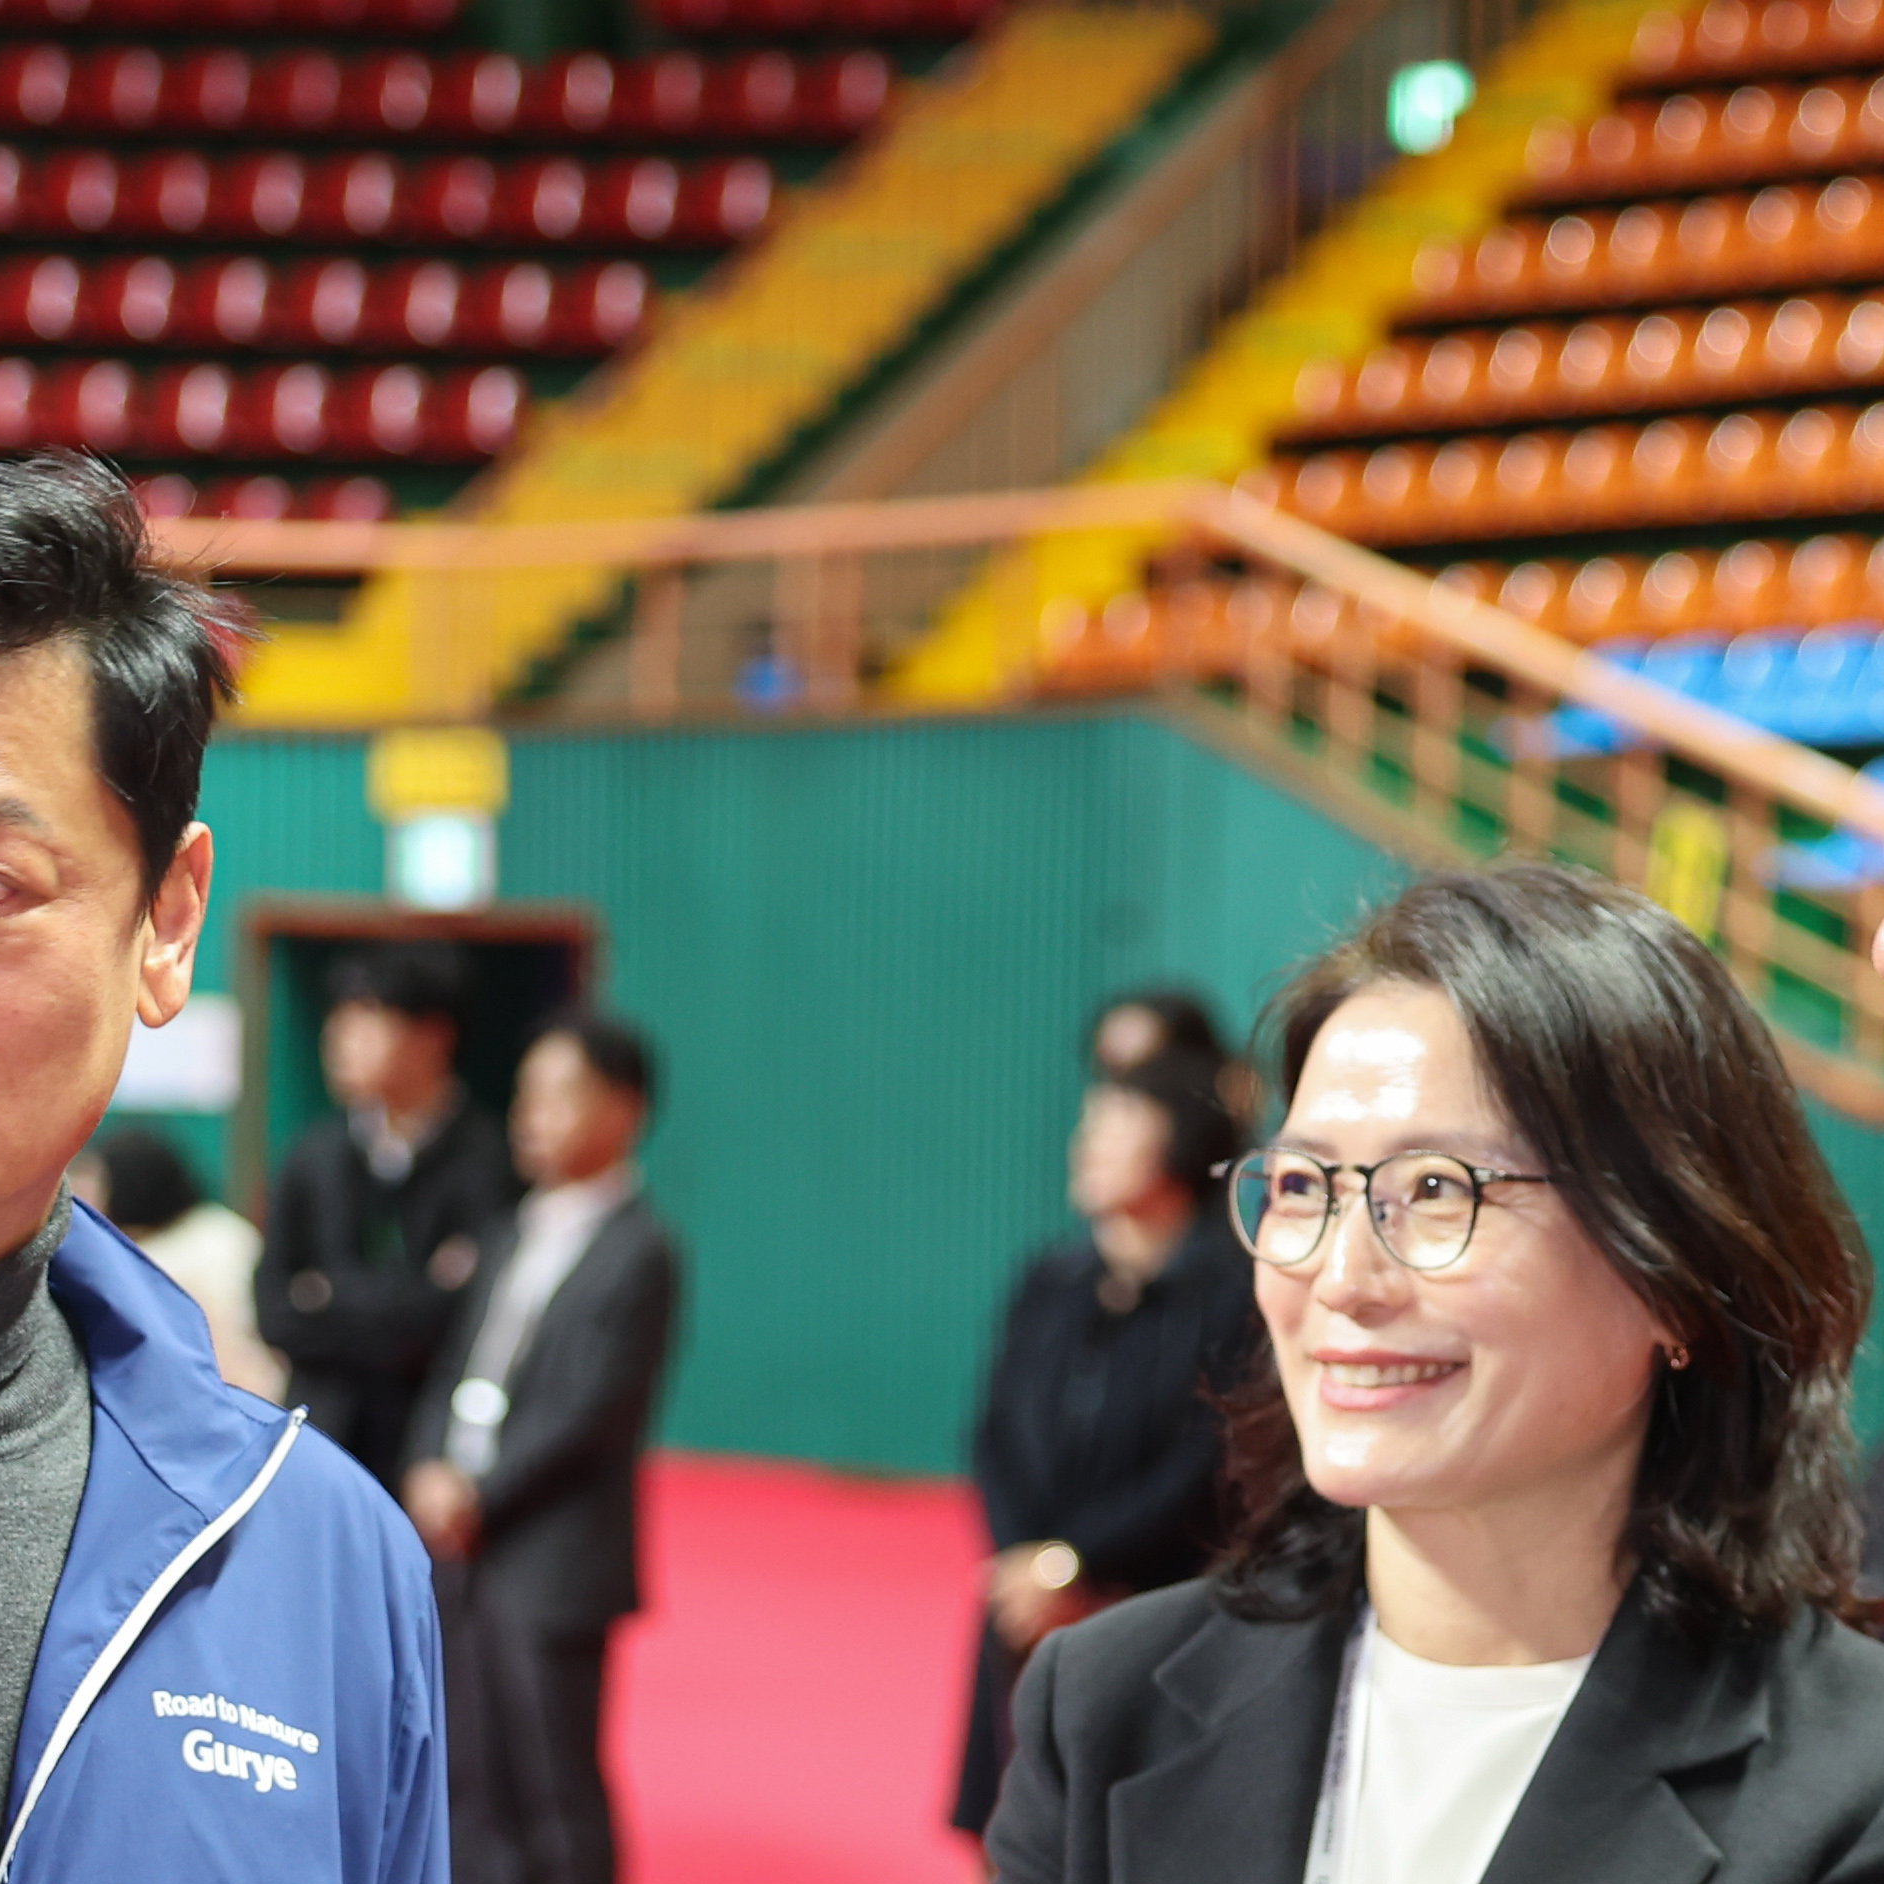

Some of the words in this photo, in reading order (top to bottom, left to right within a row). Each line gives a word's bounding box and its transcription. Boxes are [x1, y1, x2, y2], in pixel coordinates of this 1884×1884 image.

[152, 1690, 215, 1717] Road
[217, 1696, 239, 1724] to
[239, 1703, 319, 1754] Nature
[182, 1729, 298, 1792] Gurye
